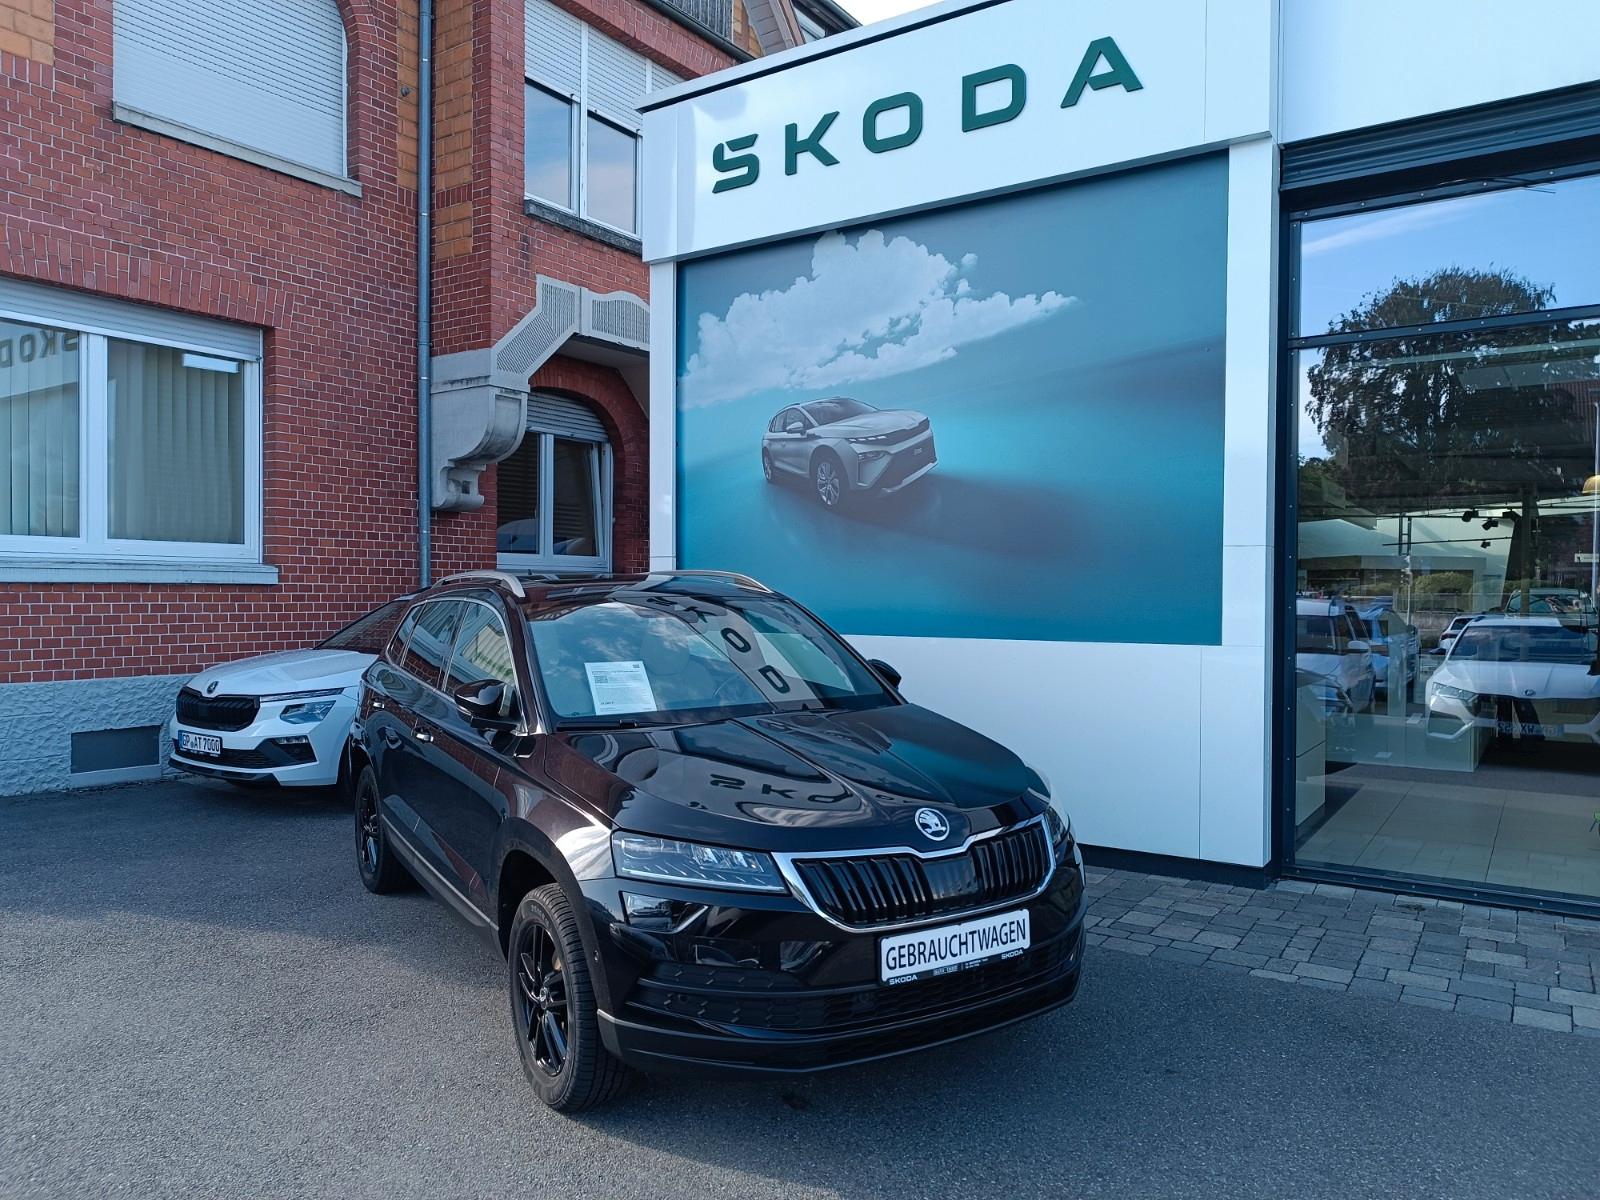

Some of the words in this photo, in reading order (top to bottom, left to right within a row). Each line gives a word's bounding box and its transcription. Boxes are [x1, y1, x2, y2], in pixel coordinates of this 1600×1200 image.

[712, 36, 1144, 194] SKODA
[886, 919, 1026, 971] GEBRAUCHTWAGEN
[1001, 949, 1024, 960] SKODA
[889, 974, 918, 985] SKODA
